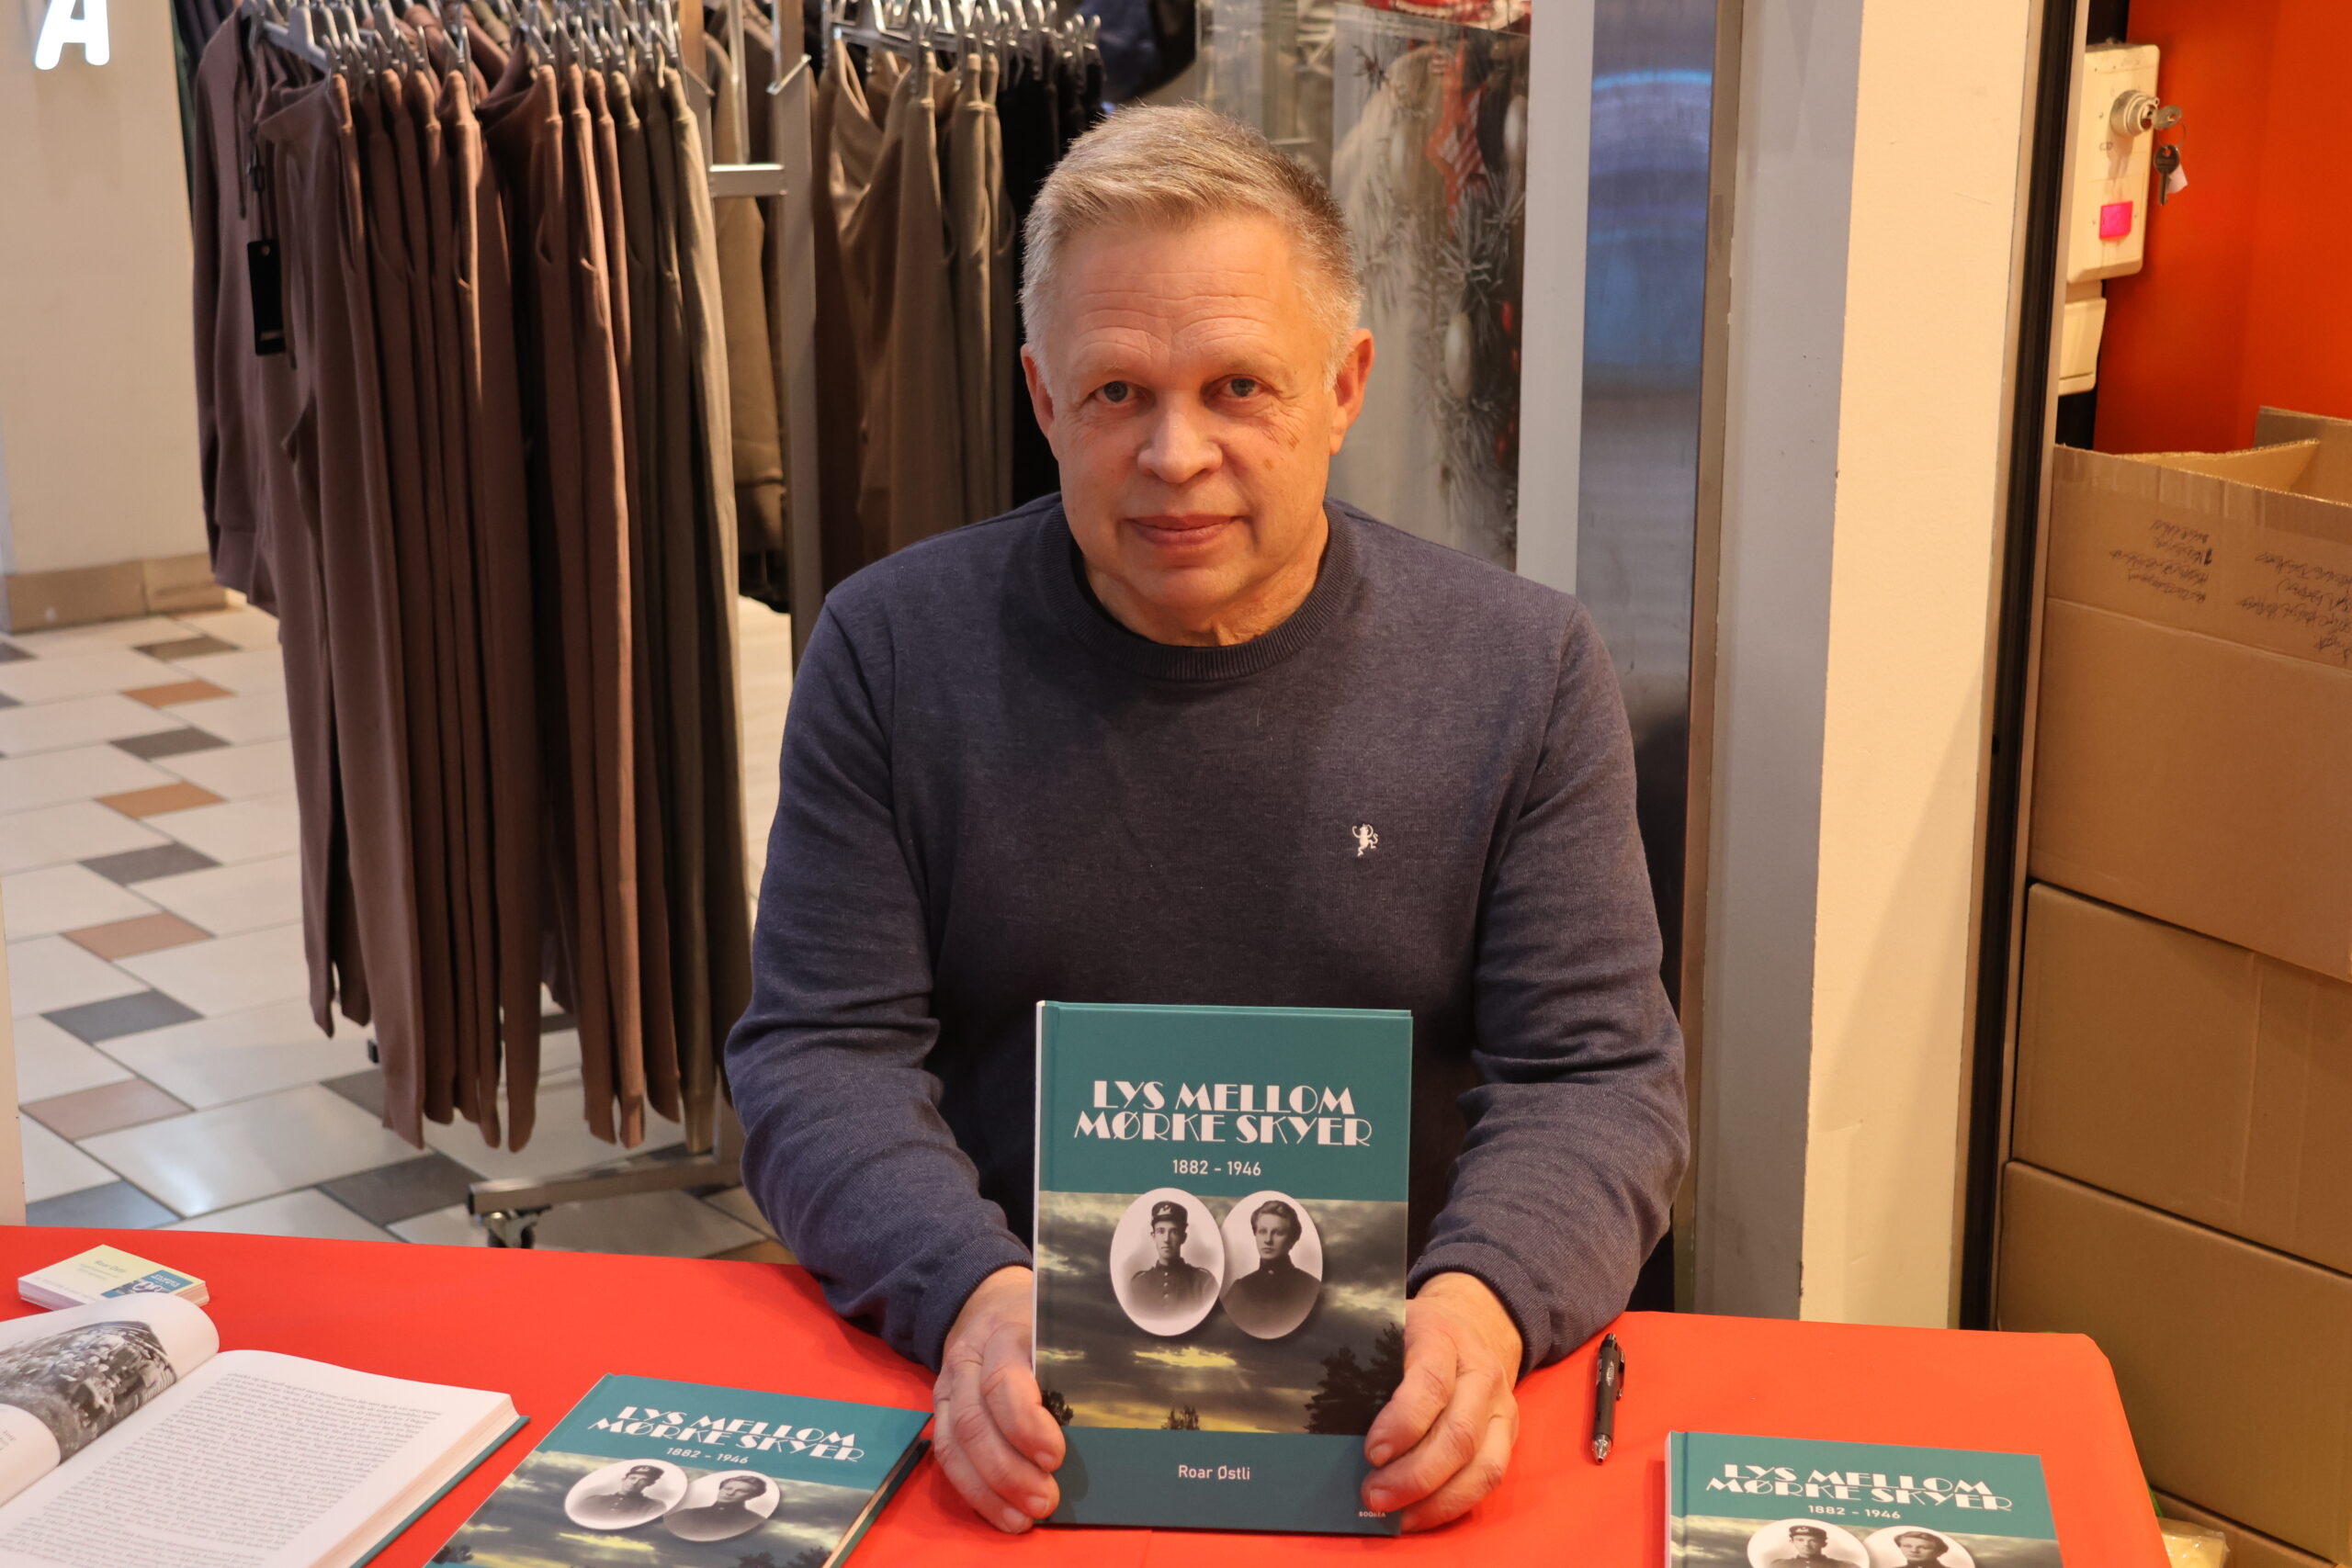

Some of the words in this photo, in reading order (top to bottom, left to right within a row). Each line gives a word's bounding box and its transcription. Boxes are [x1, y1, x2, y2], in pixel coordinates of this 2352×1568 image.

[1093, 1080, 1165, 1111] LYS
[1175, 1082, 1356, 1115] MELLOM
[1074, 1110, 1226, 1142] MØRKE
[1236, 1114, 1373, 1146] SKYER
[1172, 1159, 1208, 1175] 1882
[1227, 1160, 1261, 1176] 1946
[587, 1417, 732, 1446] MØRKE
[735, 1434, 865, 1462] SKYER
[616, 1405, 687, 1426] LYS
[689, 1415, 855, 1448] MELLOM
[666, 1447, 702, 1459] 1882
[716, 1452, 750, 1464] 1946
[1178, 1464, 1213, 1479] Roar
[1217, 1464, 1250, 1480] Østli
[1705, 1476, 1861, 1501] MØRKE
[1870, 1487, 2013, 1512] SKYER
[1724, 1463, 1797, 1482] LYS
[1807, 1469, 1993, 1495] MELLOM
[1808, 1505, 1846, 1516] 1882
[1864, 1508, 1902, 1519] 1946
